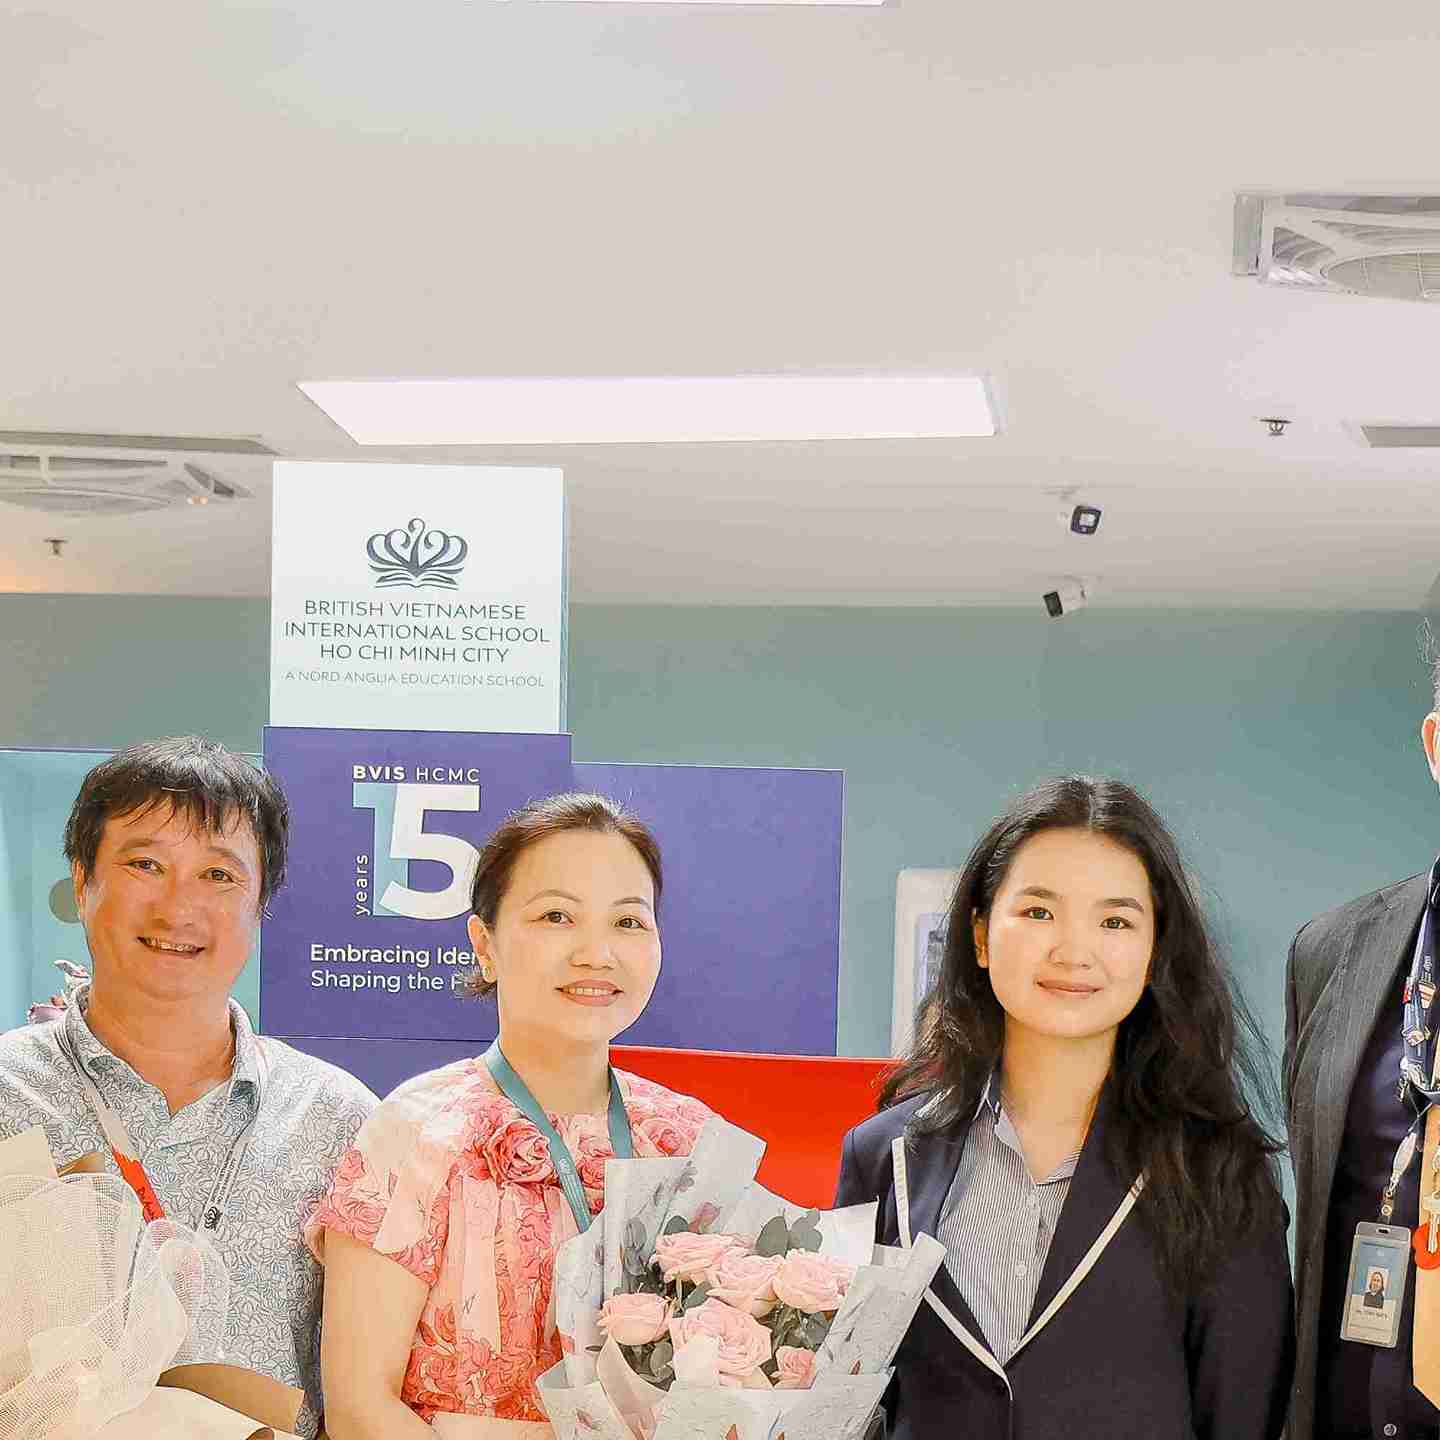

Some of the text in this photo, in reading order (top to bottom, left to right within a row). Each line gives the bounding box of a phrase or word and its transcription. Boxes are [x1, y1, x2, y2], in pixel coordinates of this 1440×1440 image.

[304, 599, 528, 620] BRITISH VIETNAMESE
[284, 621, 551, 643] INTERNATIONAL SCHOOL
[320, 643, 510, 664] HO CHI MINH CITY
[284, 670, 545, 688] A NORD ANGLIA EDUCATION SCHOOL
[352, 765, 481, 783] BVIS HCMC
[352, 782, 481, 920] 15
[355, 854, 372, 916] years
[310, 943, 431, 968] Embracing
[310, 969, 402, 993] Shaping
[408, 972, 445, 990] the
